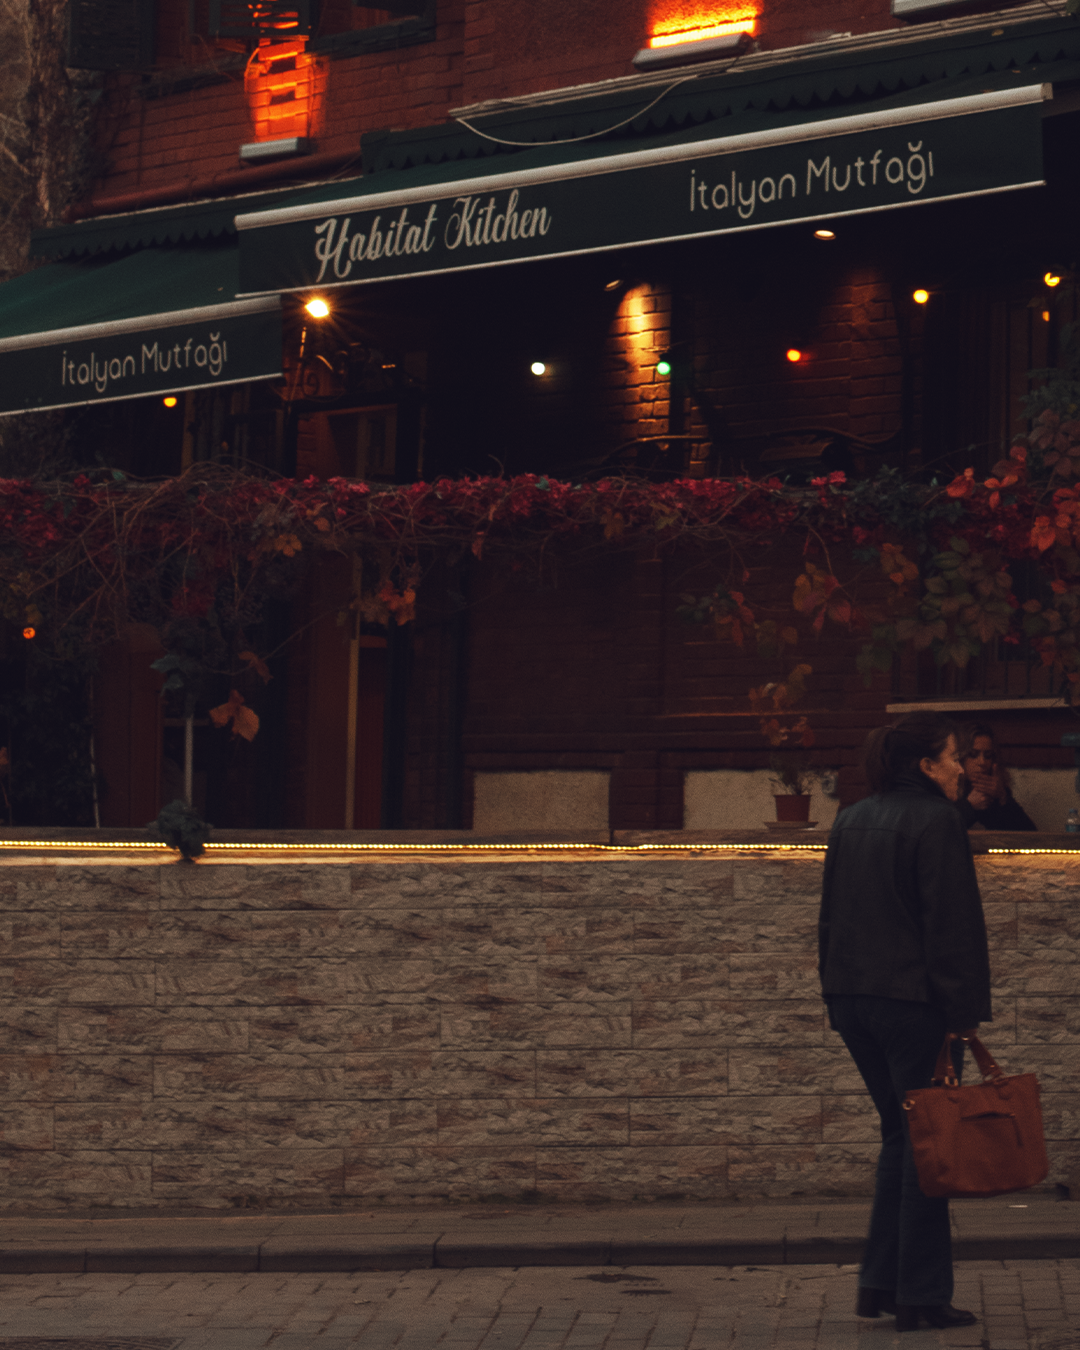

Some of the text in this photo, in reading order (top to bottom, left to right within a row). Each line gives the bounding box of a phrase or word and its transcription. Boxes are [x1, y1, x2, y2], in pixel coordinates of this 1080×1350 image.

[690, 140, 934, 219] İtalyan Mutfağı
[314, 188, 551, 283] Habitat Kitchen
[62, 331, 228, 393] İtalyan Mutfağı
